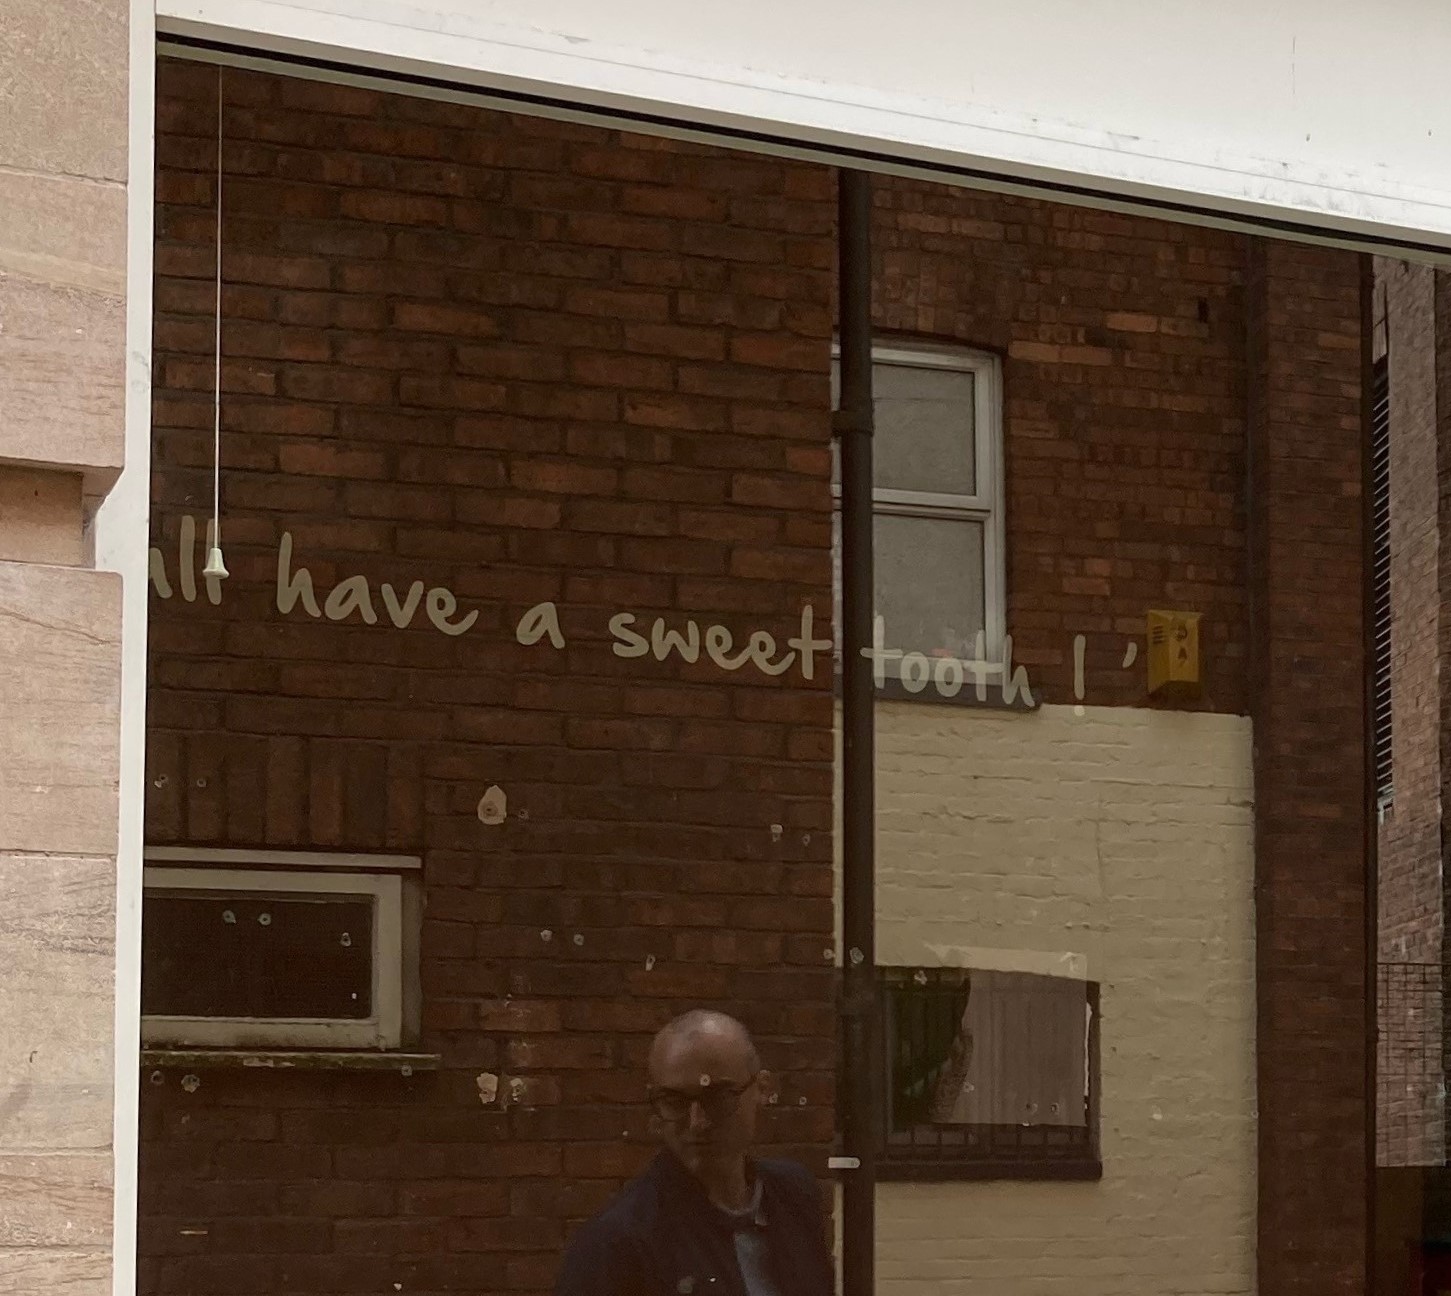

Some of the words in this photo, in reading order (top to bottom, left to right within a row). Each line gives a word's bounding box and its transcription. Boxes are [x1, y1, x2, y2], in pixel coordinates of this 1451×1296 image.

[276, 531, 479, 635] have
[516, 600, 566, 650] a
[608, 604, 833, 681] sweet
[860, 614, 1036, 708] tooth
